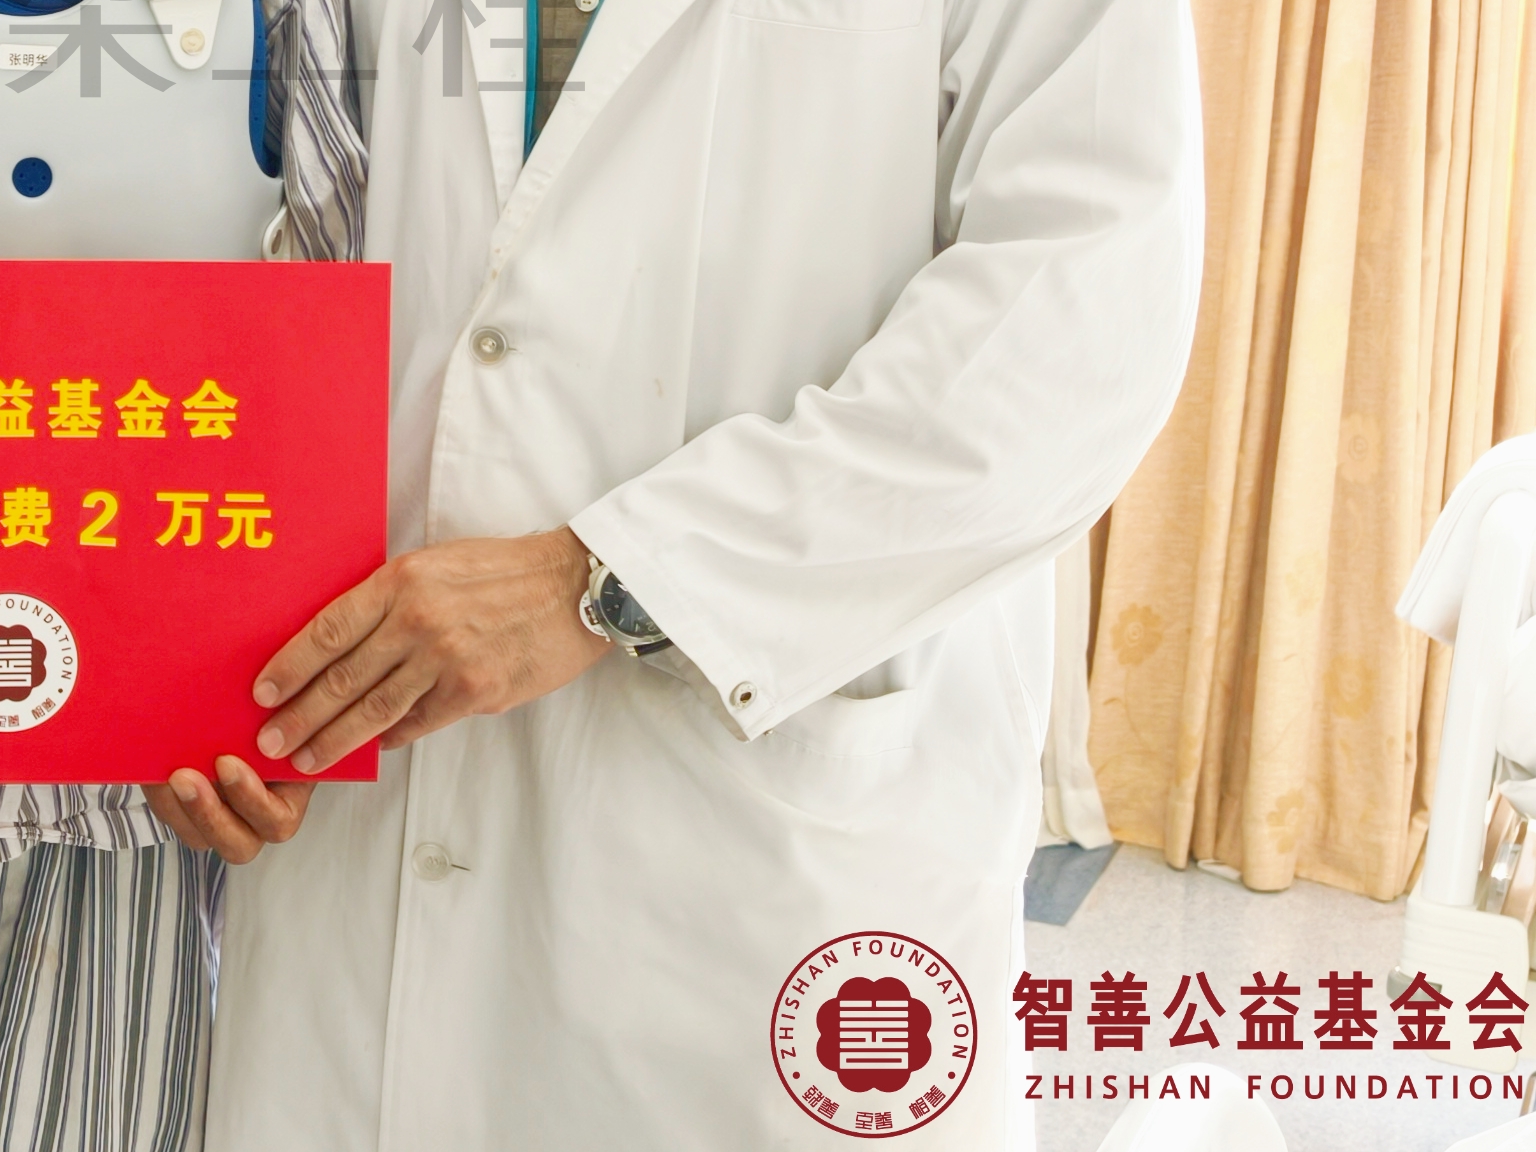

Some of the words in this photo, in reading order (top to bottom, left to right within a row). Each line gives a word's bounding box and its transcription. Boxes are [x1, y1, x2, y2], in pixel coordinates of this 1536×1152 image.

[9, 53, 48, 66] 张明华
[79, 491, 118, 547] 2
[155, 491, 274, 549] 万元
